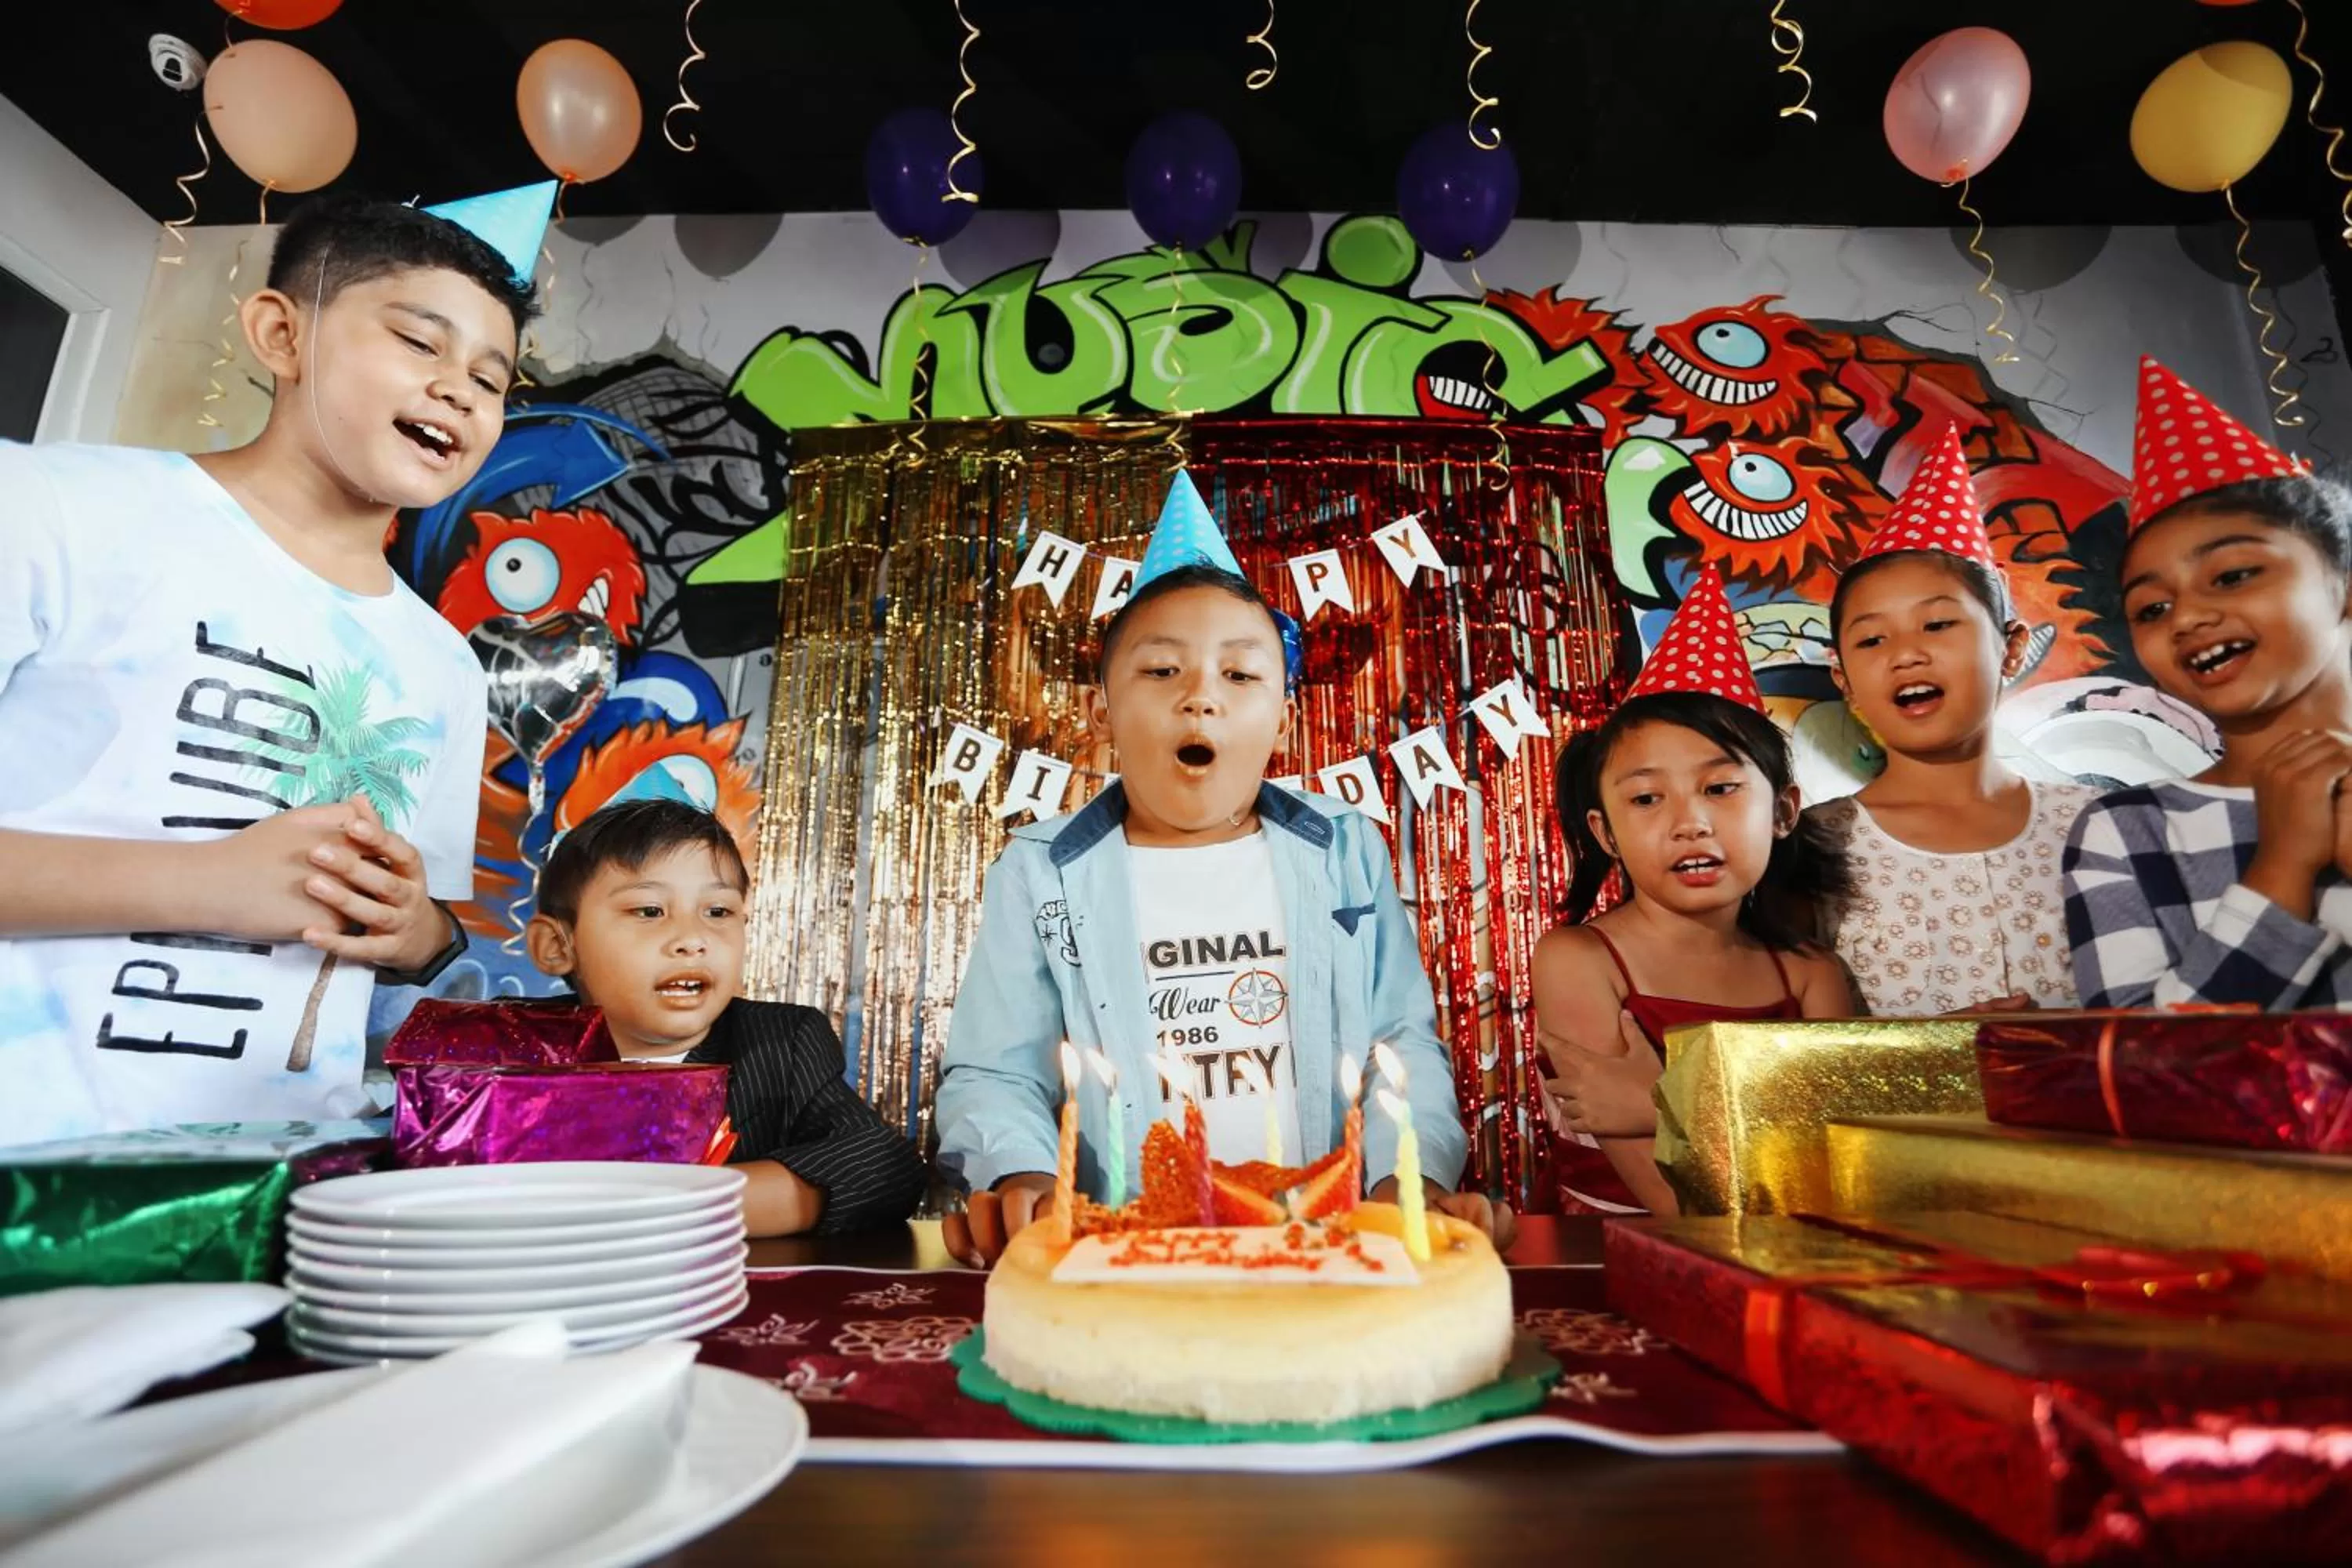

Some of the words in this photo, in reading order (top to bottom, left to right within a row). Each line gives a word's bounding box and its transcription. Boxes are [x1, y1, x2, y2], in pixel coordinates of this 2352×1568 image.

[1037, 529, 1417, 598] HAPY
[953, 693, 1515, 806] BIDAY
[1148, 931, 1284, 968] GINAL
[96, 930, 273, 1059] EPI
[1149, 987, 1221, 1021] Wear
[1156, 1026, 1219, 1047] 1986
